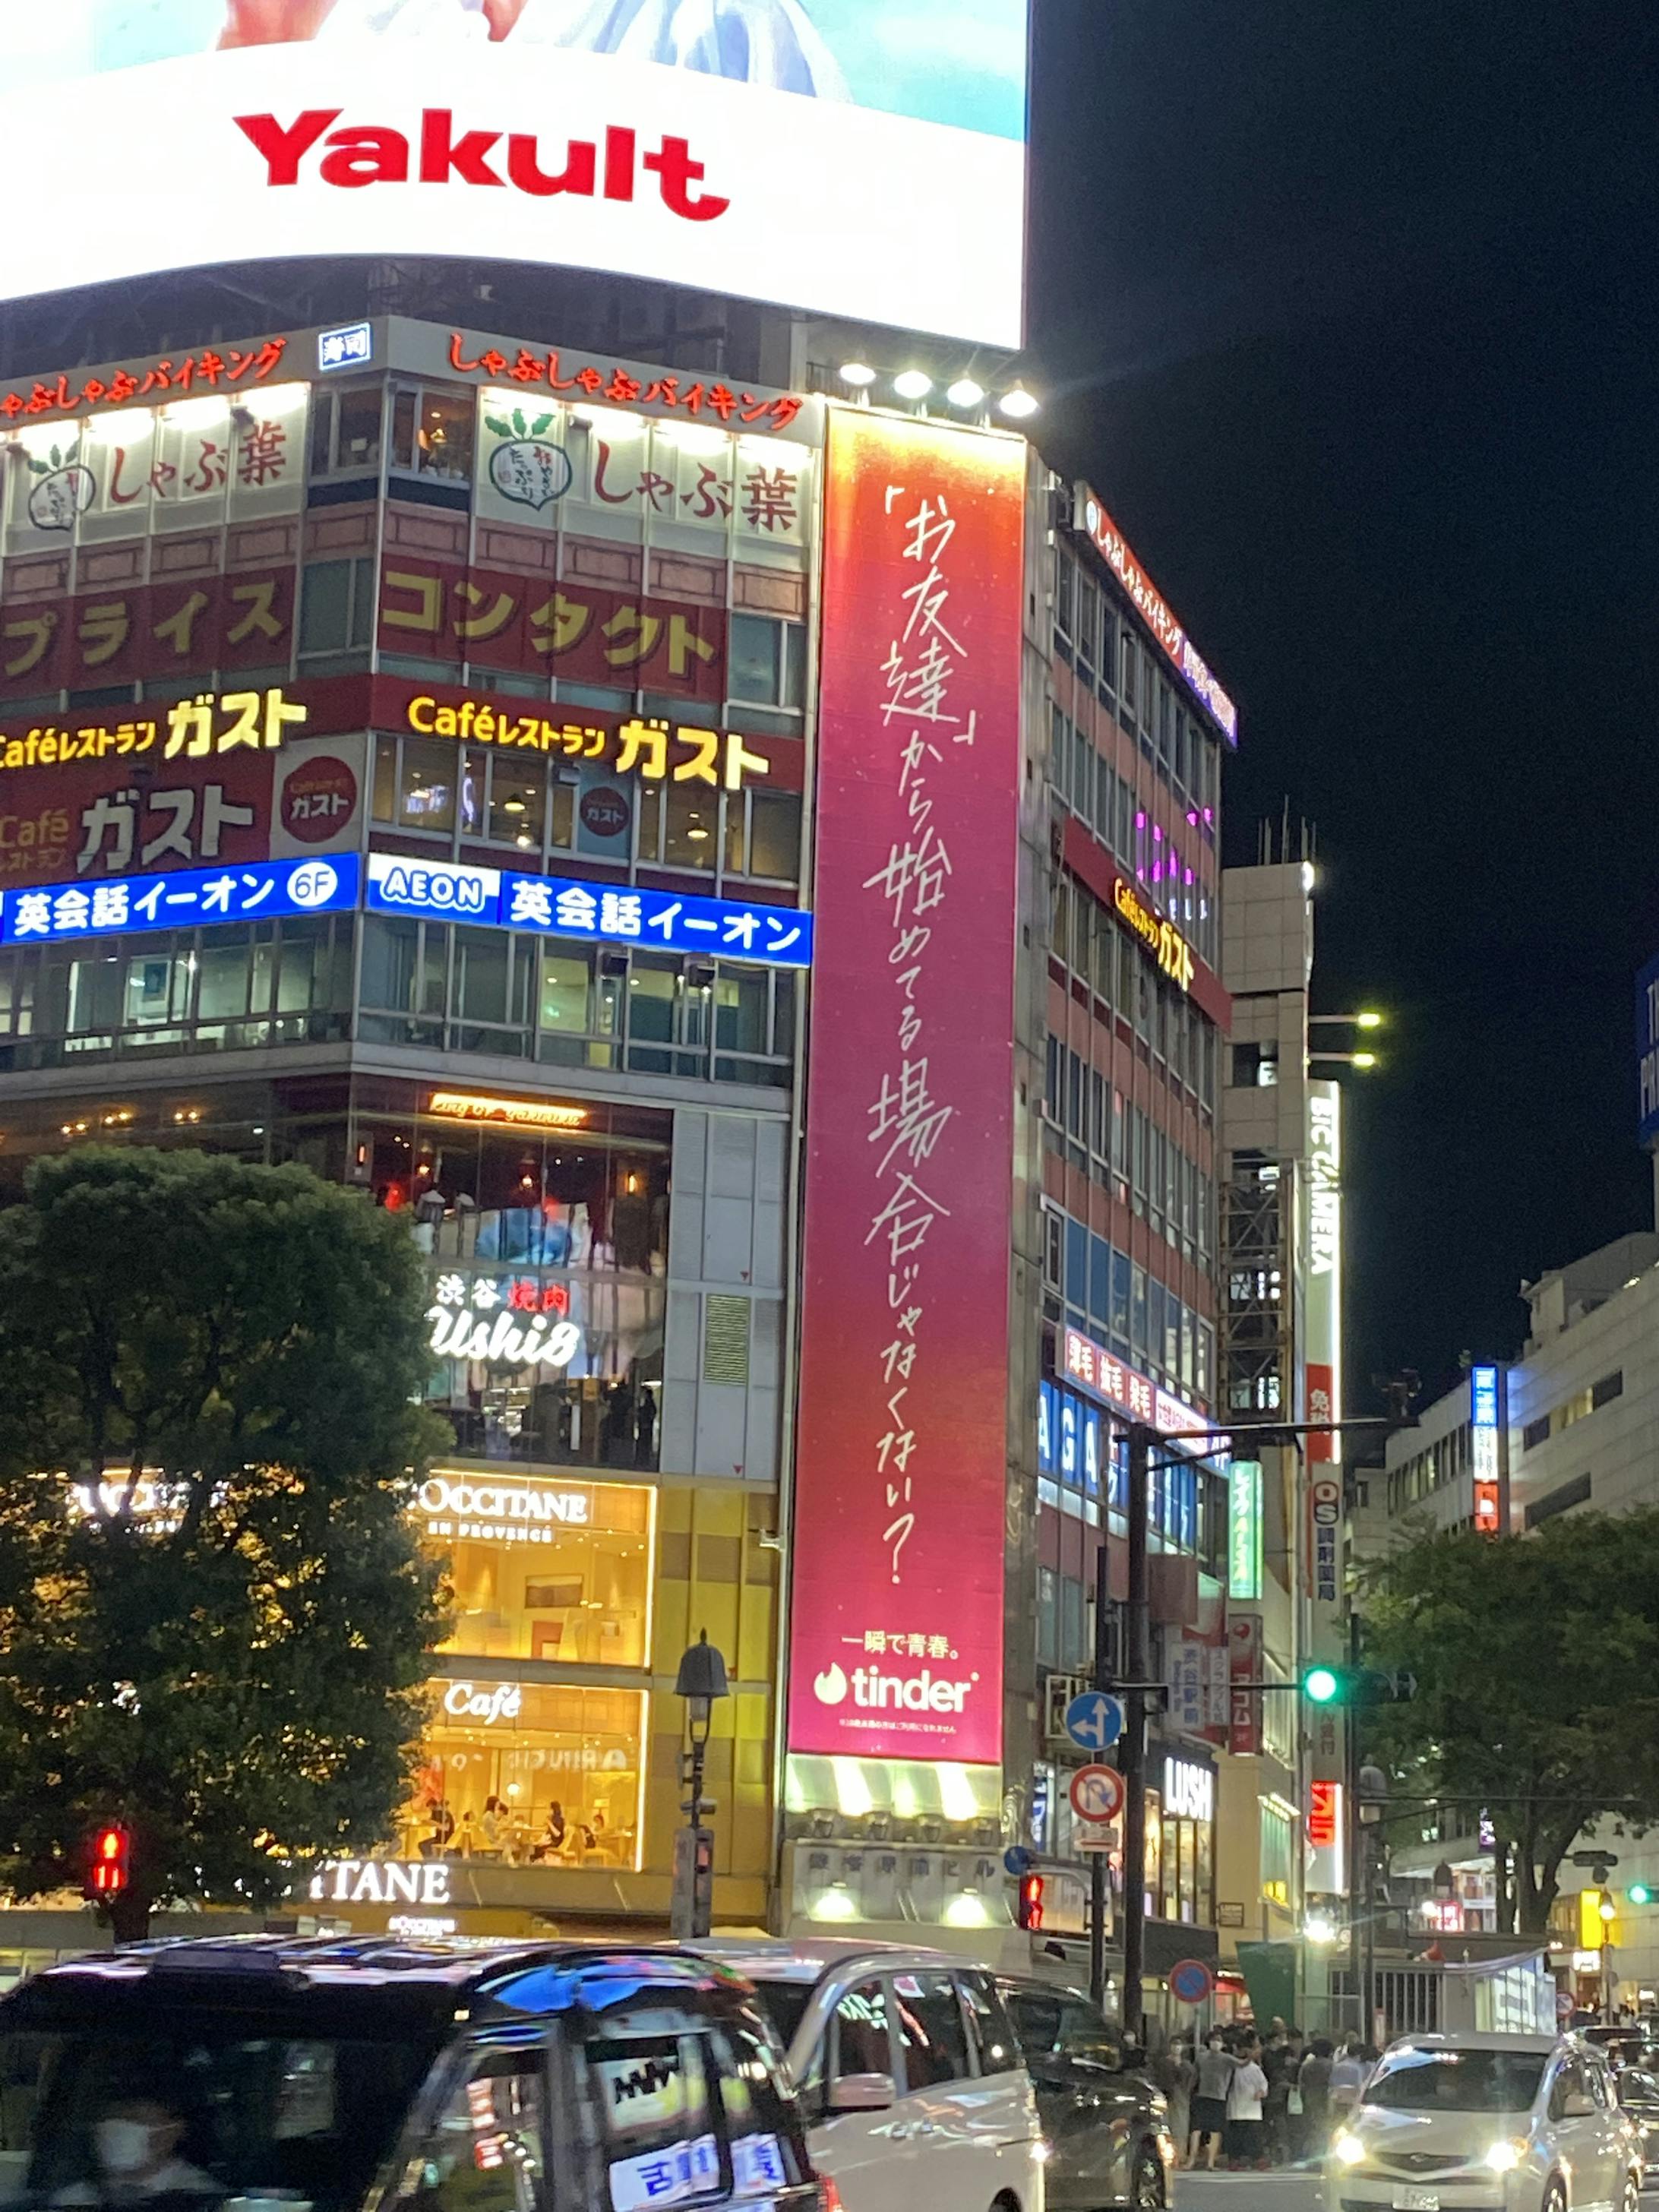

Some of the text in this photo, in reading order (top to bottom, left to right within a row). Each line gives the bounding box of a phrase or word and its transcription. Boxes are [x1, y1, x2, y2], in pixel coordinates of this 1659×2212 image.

[232, 107, 732, 222] Yakult
[324, 329, 366, 363] 寿司
[449, 333, 804, 431] しゃぶしゃぶバイキング
[110, 420, 286, 503] しゃぶ葉
[594, 440, 798, 532] しゃぶ葉
[5, 580, 285, 677] プライス
[381, 571, 715, 675] コンタクト
[164, 688, 307, 759] ガスト
[407, 696, 770, 792] Caféレストラン ガスト
[0, 808, 70, 848] Café
[77, 784, 254, 874] ガスト
[290, 793, 349, 820] ガスト
[14, 870, 330, 937] 英会話イーオン 6F
[383, 866, 482, 914] AEON
[510, 880, 801, 952] 英会話イーオン
[1158, 920, 1194, 992] ガスト
[1310, 1096, 1334, 1275] BIC CAMERA
[841, 1629, 959, 1660] 一瞬で青春。
[444, 1683, 522, 1725] Café
[850, 1664, 972, 1713] tinder
[1164, 1756, 1213, 1822] LUSH
